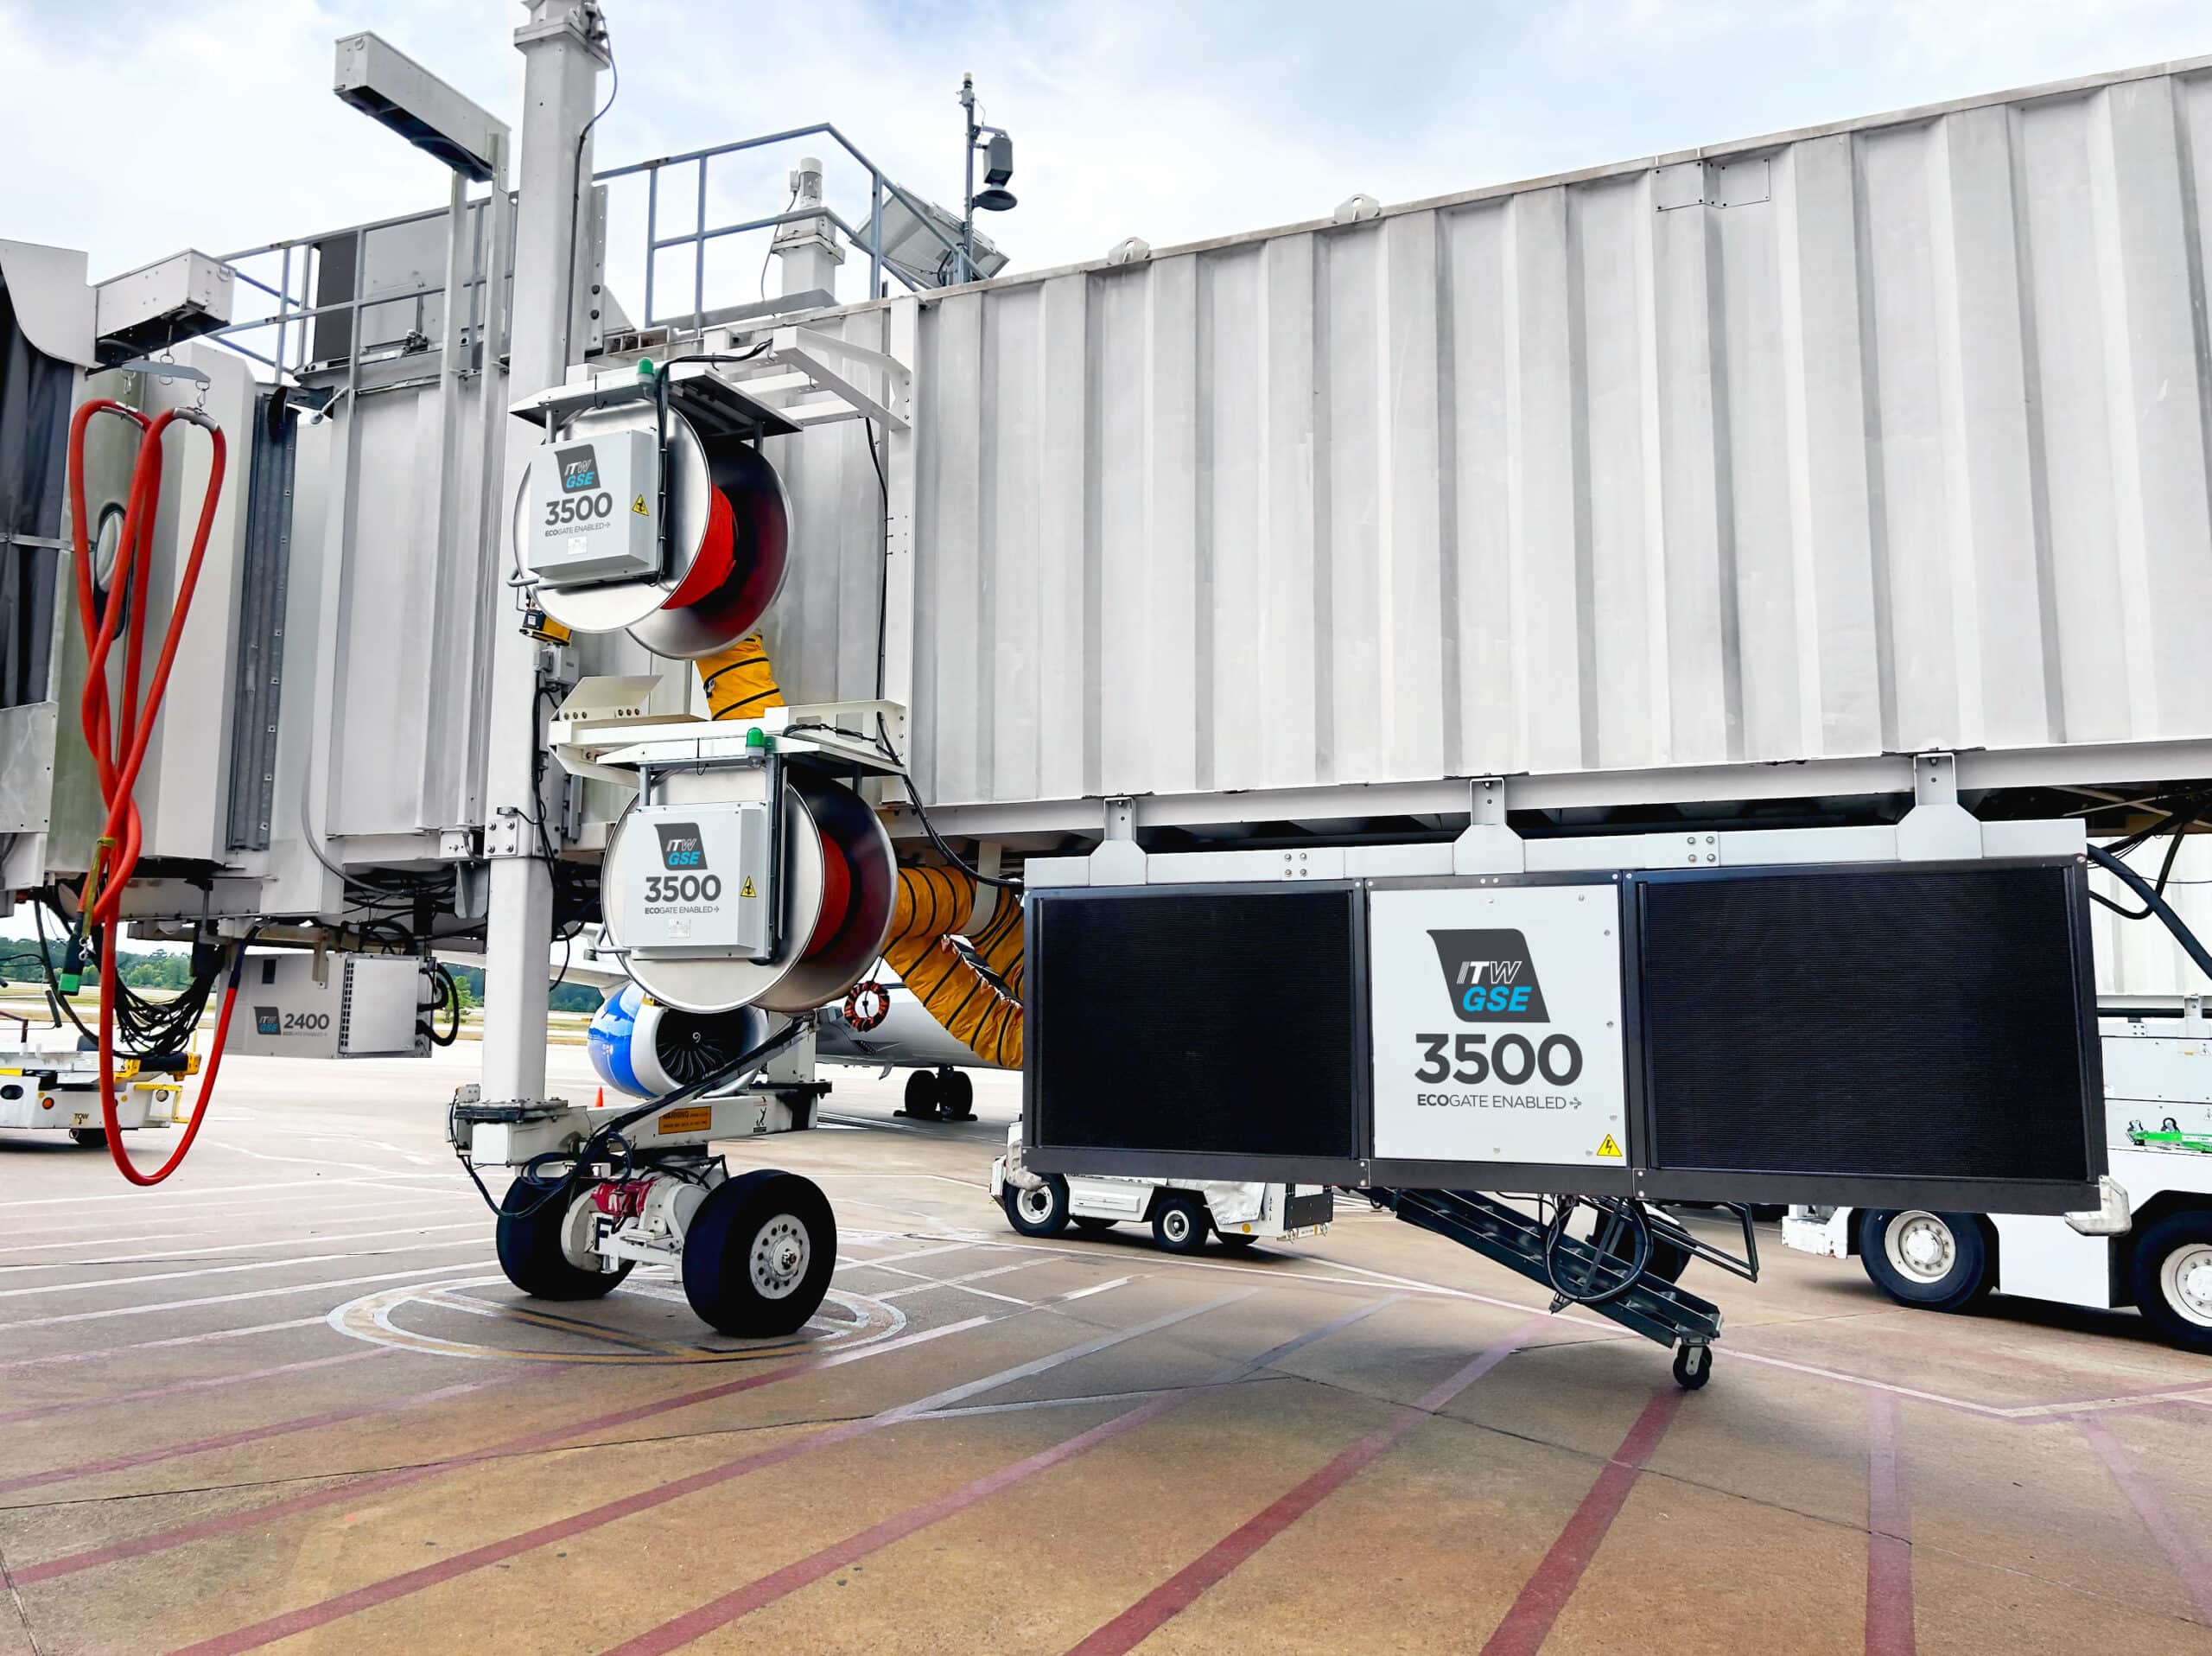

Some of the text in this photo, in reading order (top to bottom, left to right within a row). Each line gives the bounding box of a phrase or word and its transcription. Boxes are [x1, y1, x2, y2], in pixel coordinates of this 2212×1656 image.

[564, 459, 592, 475] ITW
[566, 471, 595, 488] GSE
[544, 492, 613, 525] 3500
[544, 522, 603, 537] ECOGATE ENABLED
[665, 838, 696, 851] ITW
[668, 851, 701, 866] GSE
[644, 875, 721, 902] 3500
[1456, 961, 1522, 984] ITW
[1462, 985, 1533, 1012] GSE
[283, 1013, 329, 1029] 2400
[1414, 1033, 1583, 1086] 3500
[1417, 1093, 1567, 1110] ECOGATE ENABLED
